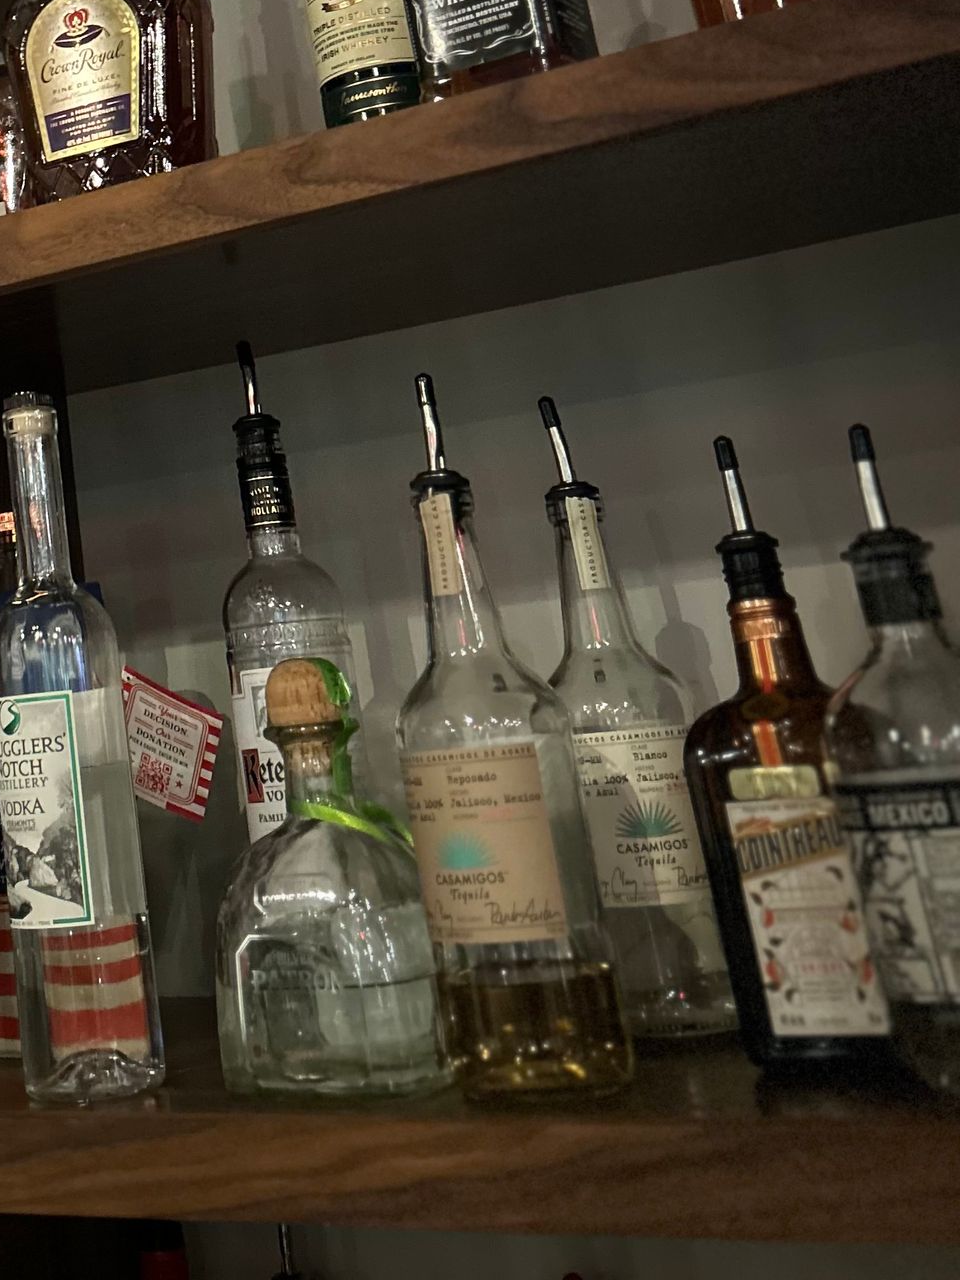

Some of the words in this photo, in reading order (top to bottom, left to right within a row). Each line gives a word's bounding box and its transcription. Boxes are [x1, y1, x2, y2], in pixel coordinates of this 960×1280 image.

[313, 18, 336, 36] TRIPLE
[338, 6, 392, 24] DISTILLED
[321, 47, 340, 63] IRISH
[340, 34, 389, 53] WHISKEY
[41, 57, 81, 84] Crown
[76, 39, 126, 76] Royal
[52, 85, 73, 95] FINE
[76, 81, 89, 90] DE
[249, 485, 270, 497] VISIT
[155, 727, 173, 741] Our
[609, 731, 661, 742] CASAMIGOS
[426, 752, 478, 763] CASAMIGOS
[632, 751, 668, 762] Blanco
[242, 754, 285, 799] Kete
[446, 771, 498, 786] Reposado
[603, 773, 630, 786] 100%
[635, 772, 680, 784] Jalisco,
[1, 797, 46, 817] VODKA
[449, 797, 499, 809] Jalisco,
[258, 813, 284, 823] FAMIL
[866, 799, 951, 826] MEXICO
[616, 838, 689, 855] CASAMIGOS
[635, 853, 677, 871] Tequila
[435, 871, 506, 887] CASAMIGOS
[449, 887, 491, 905] Tequila
